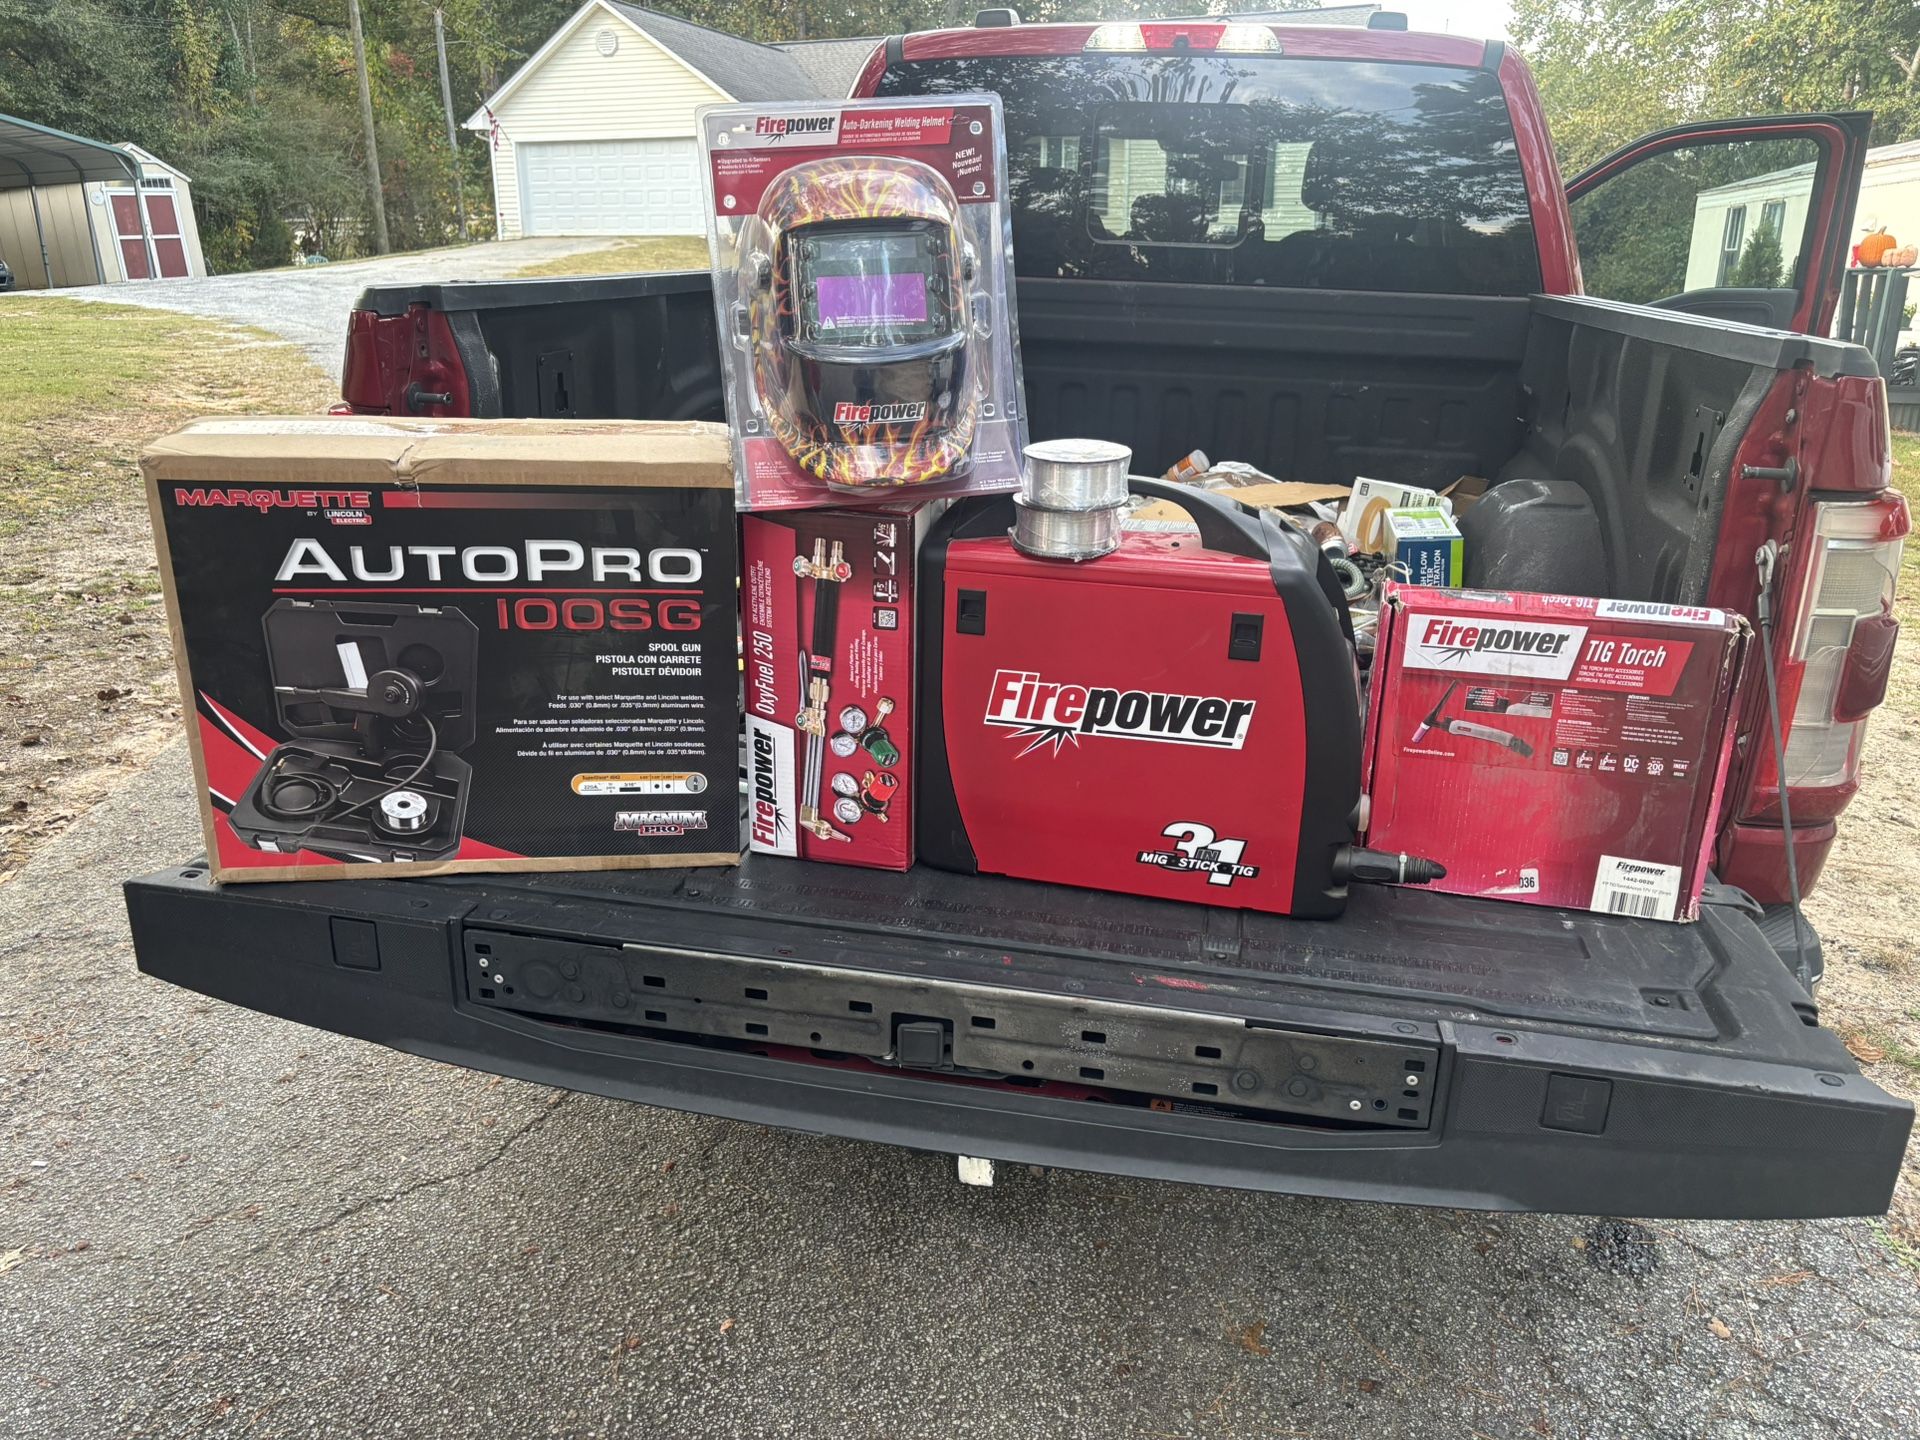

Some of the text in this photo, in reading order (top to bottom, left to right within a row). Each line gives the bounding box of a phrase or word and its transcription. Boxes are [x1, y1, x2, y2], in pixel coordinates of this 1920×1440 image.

[755, 115, 836, 136] Firepower
[842, 115, 945, 130] Auto-Darkening Welding Helmet
[955, 147, 975, 160] NEW!
[952, 154, 983, 169] Nouveau!
[835, 401, 926, 422] Firepower
[174, 488, 370, 514] MARQUETTE
[326, 510, 363, 518] LINCOLN
[648, 643, 701, 652] SPOOL GUN
[1421, 619, 1667, 668] Firepower TIG Torch
[596, 655, 702, 664] PISTOLA CON CARRETE
[612, 666, 702, 676] PISTOLET DÉVIDOIR
[752, 630, 778, 714] OxyFuel 250
[586, 702, 611, 710] (0.8mm)
[986, 671, 1254, 739] Firepower
[1403, 746, 1455, 757] FirepowerOnline.com
[1624, 758, 1639, 768] DC
[1647, 762, 1664, 772] 200
[753, 727, 777, 847] Firepower
[614, 811, 707, 831] MAGNUM
[642, 825, 679, 834] PRO
[1162, 822, 1247, 885] 3 IN 1
[1140, 852, 1255, 877] MIG STICK TIG
[1616, 861, 1666, 876] Firepower
